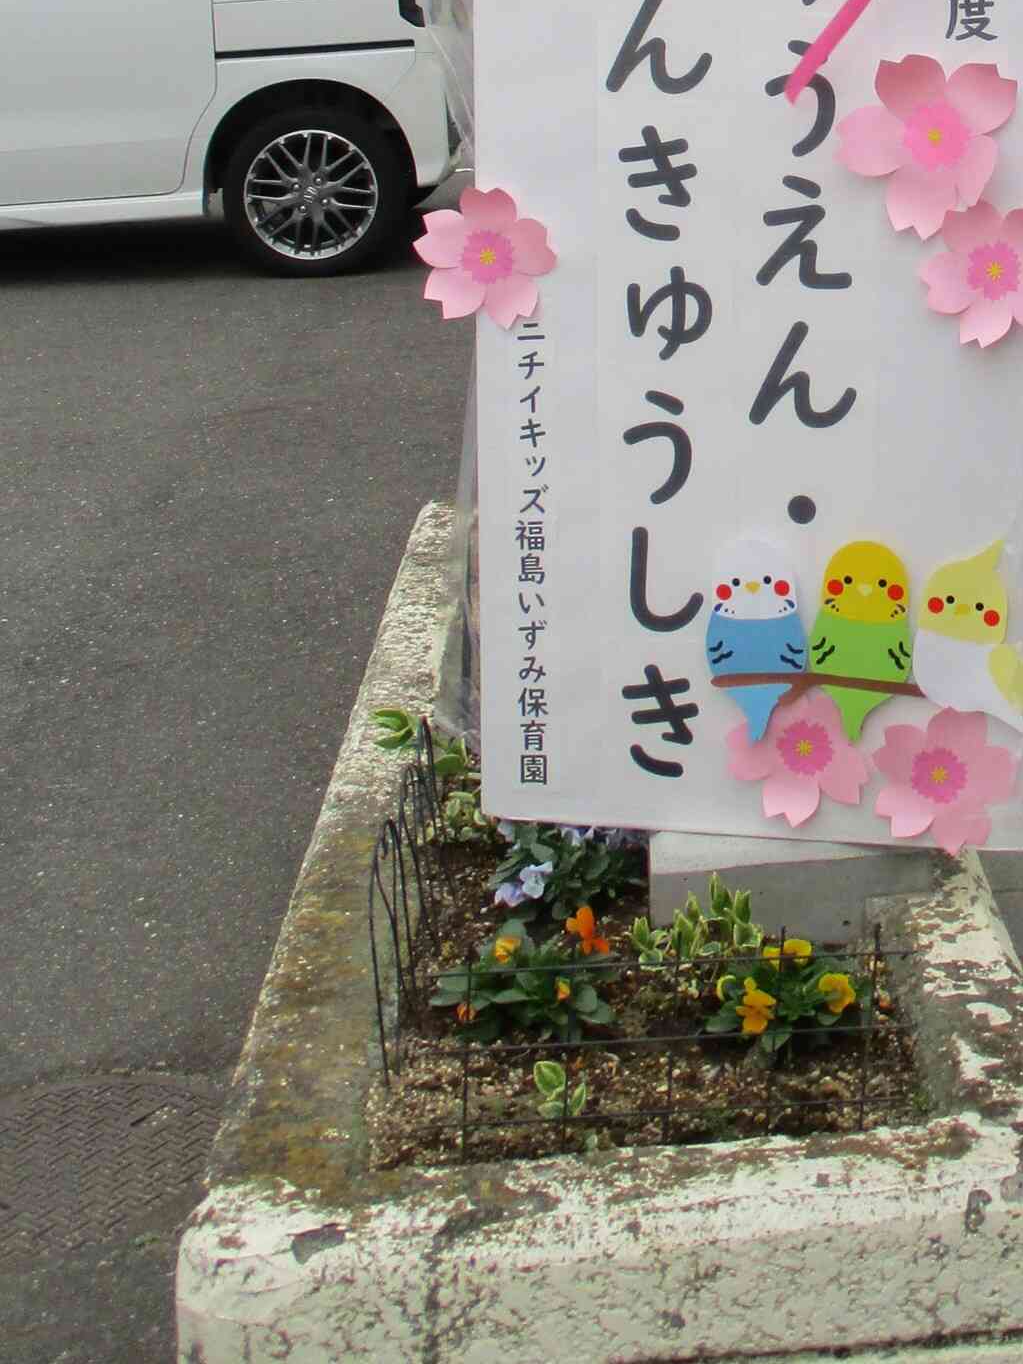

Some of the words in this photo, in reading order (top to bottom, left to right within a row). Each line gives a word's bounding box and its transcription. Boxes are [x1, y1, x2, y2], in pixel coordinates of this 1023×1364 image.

[515, 322, 548, 786] ニチイキッズ福島いずみ保育園
